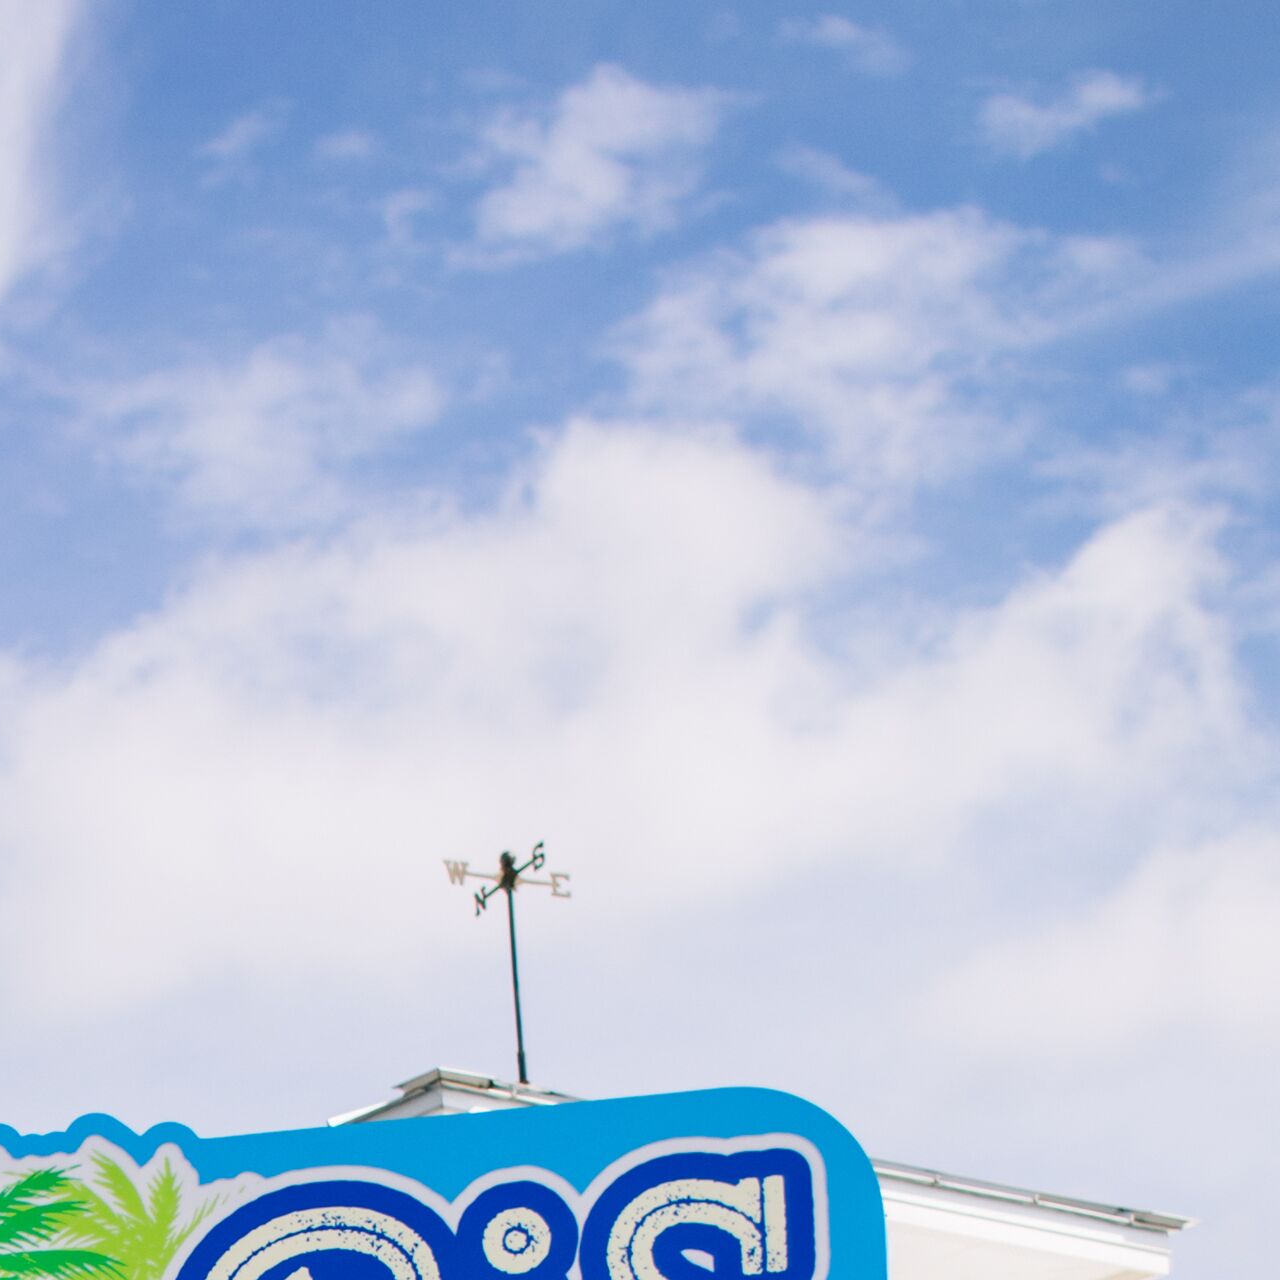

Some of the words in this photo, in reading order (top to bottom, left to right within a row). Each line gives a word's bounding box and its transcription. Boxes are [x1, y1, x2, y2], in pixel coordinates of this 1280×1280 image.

[443, 859, 469, 886] W
[550, 873, 572, 898] E
[474, 886, 486, 917] N
